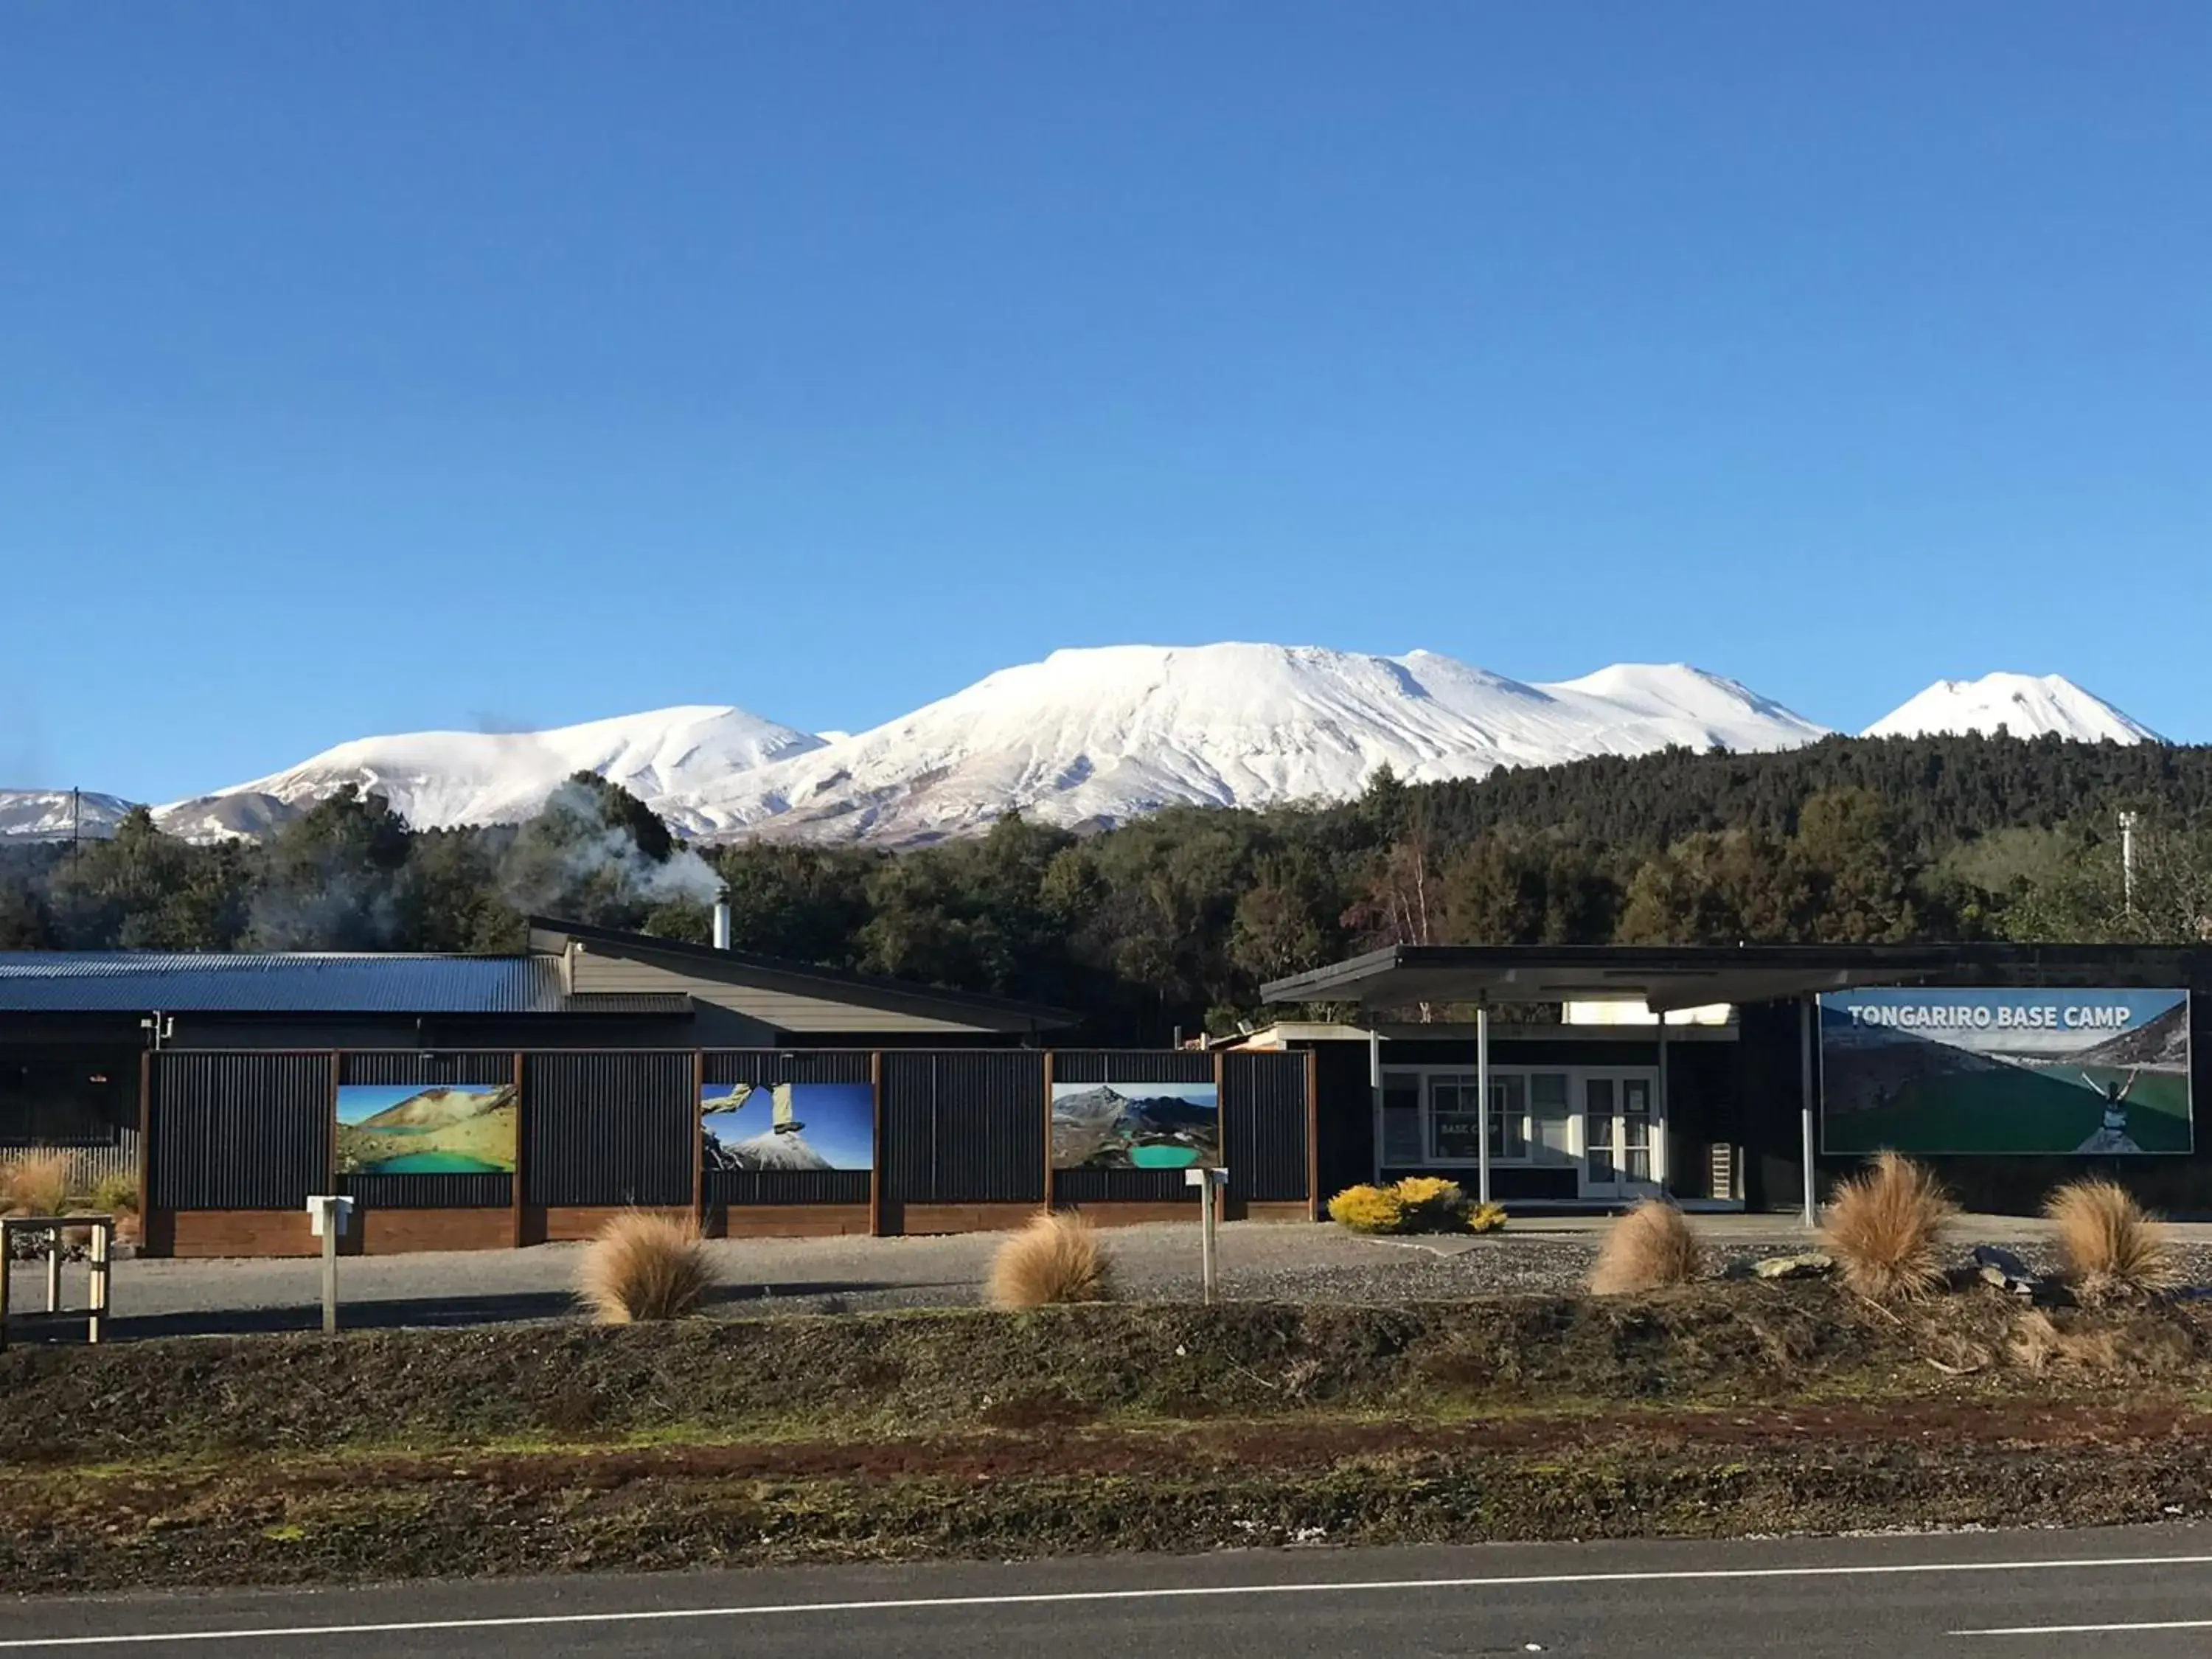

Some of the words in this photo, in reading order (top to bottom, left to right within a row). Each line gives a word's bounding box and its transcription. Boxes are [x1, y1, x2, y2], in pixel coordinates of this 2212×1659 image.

[1848, 1005, 1991, 1028] TONGARIRO
[1997, 1006, 2057, 1027] BASE
[2063, 1006, 2132, 1028] CAMP
